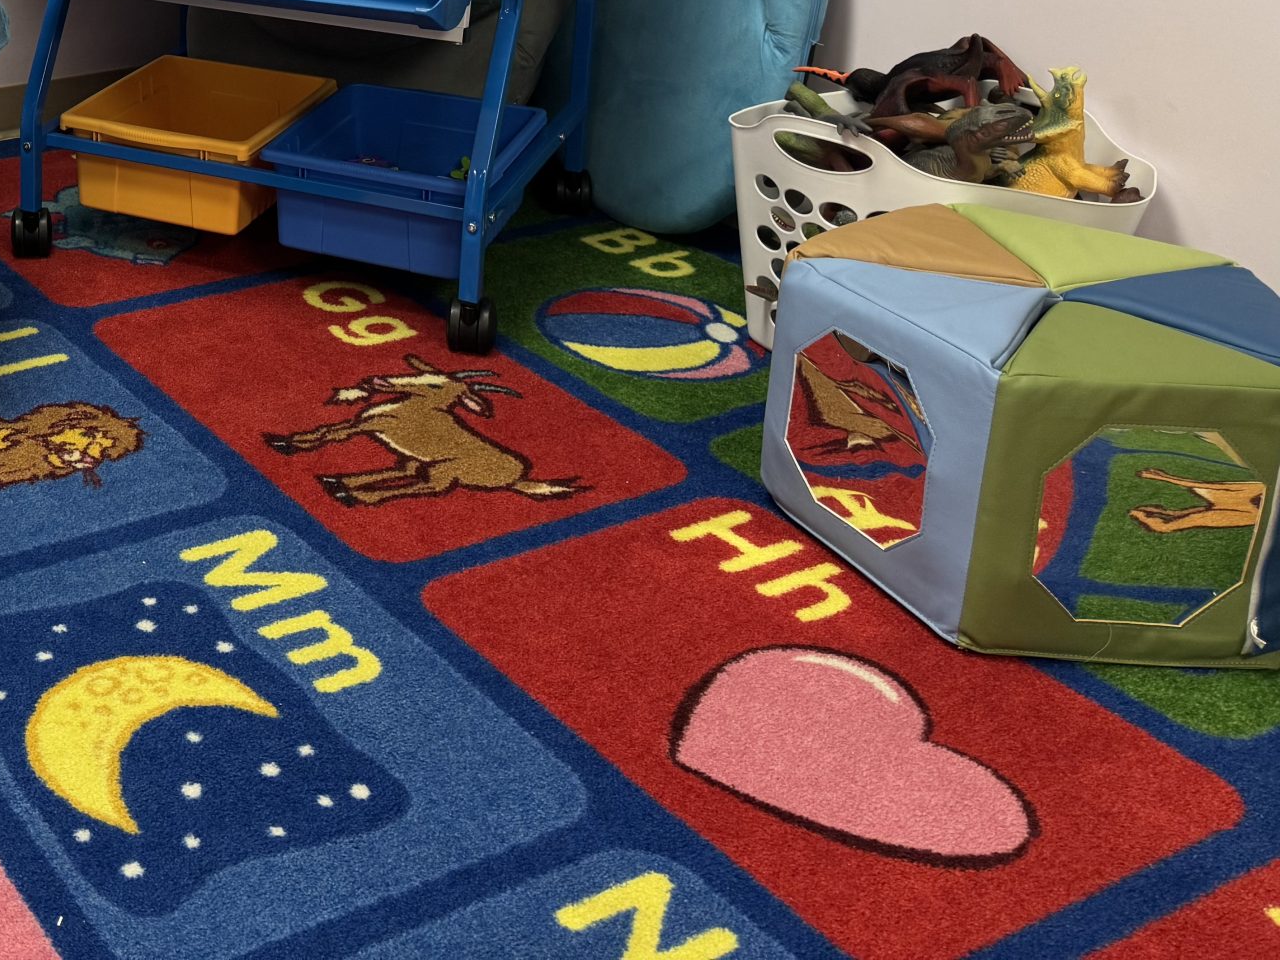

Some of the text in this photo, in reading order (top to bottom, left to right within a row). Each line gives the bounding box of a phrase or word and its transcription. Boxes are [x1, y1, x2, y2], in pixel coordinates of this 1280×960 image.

[580, 229, 697, 279] Bb
[303, 281, 418, 346] Gg
[670, 508, 851, 623] Hh
[181, 530, 382, 694] Mm
